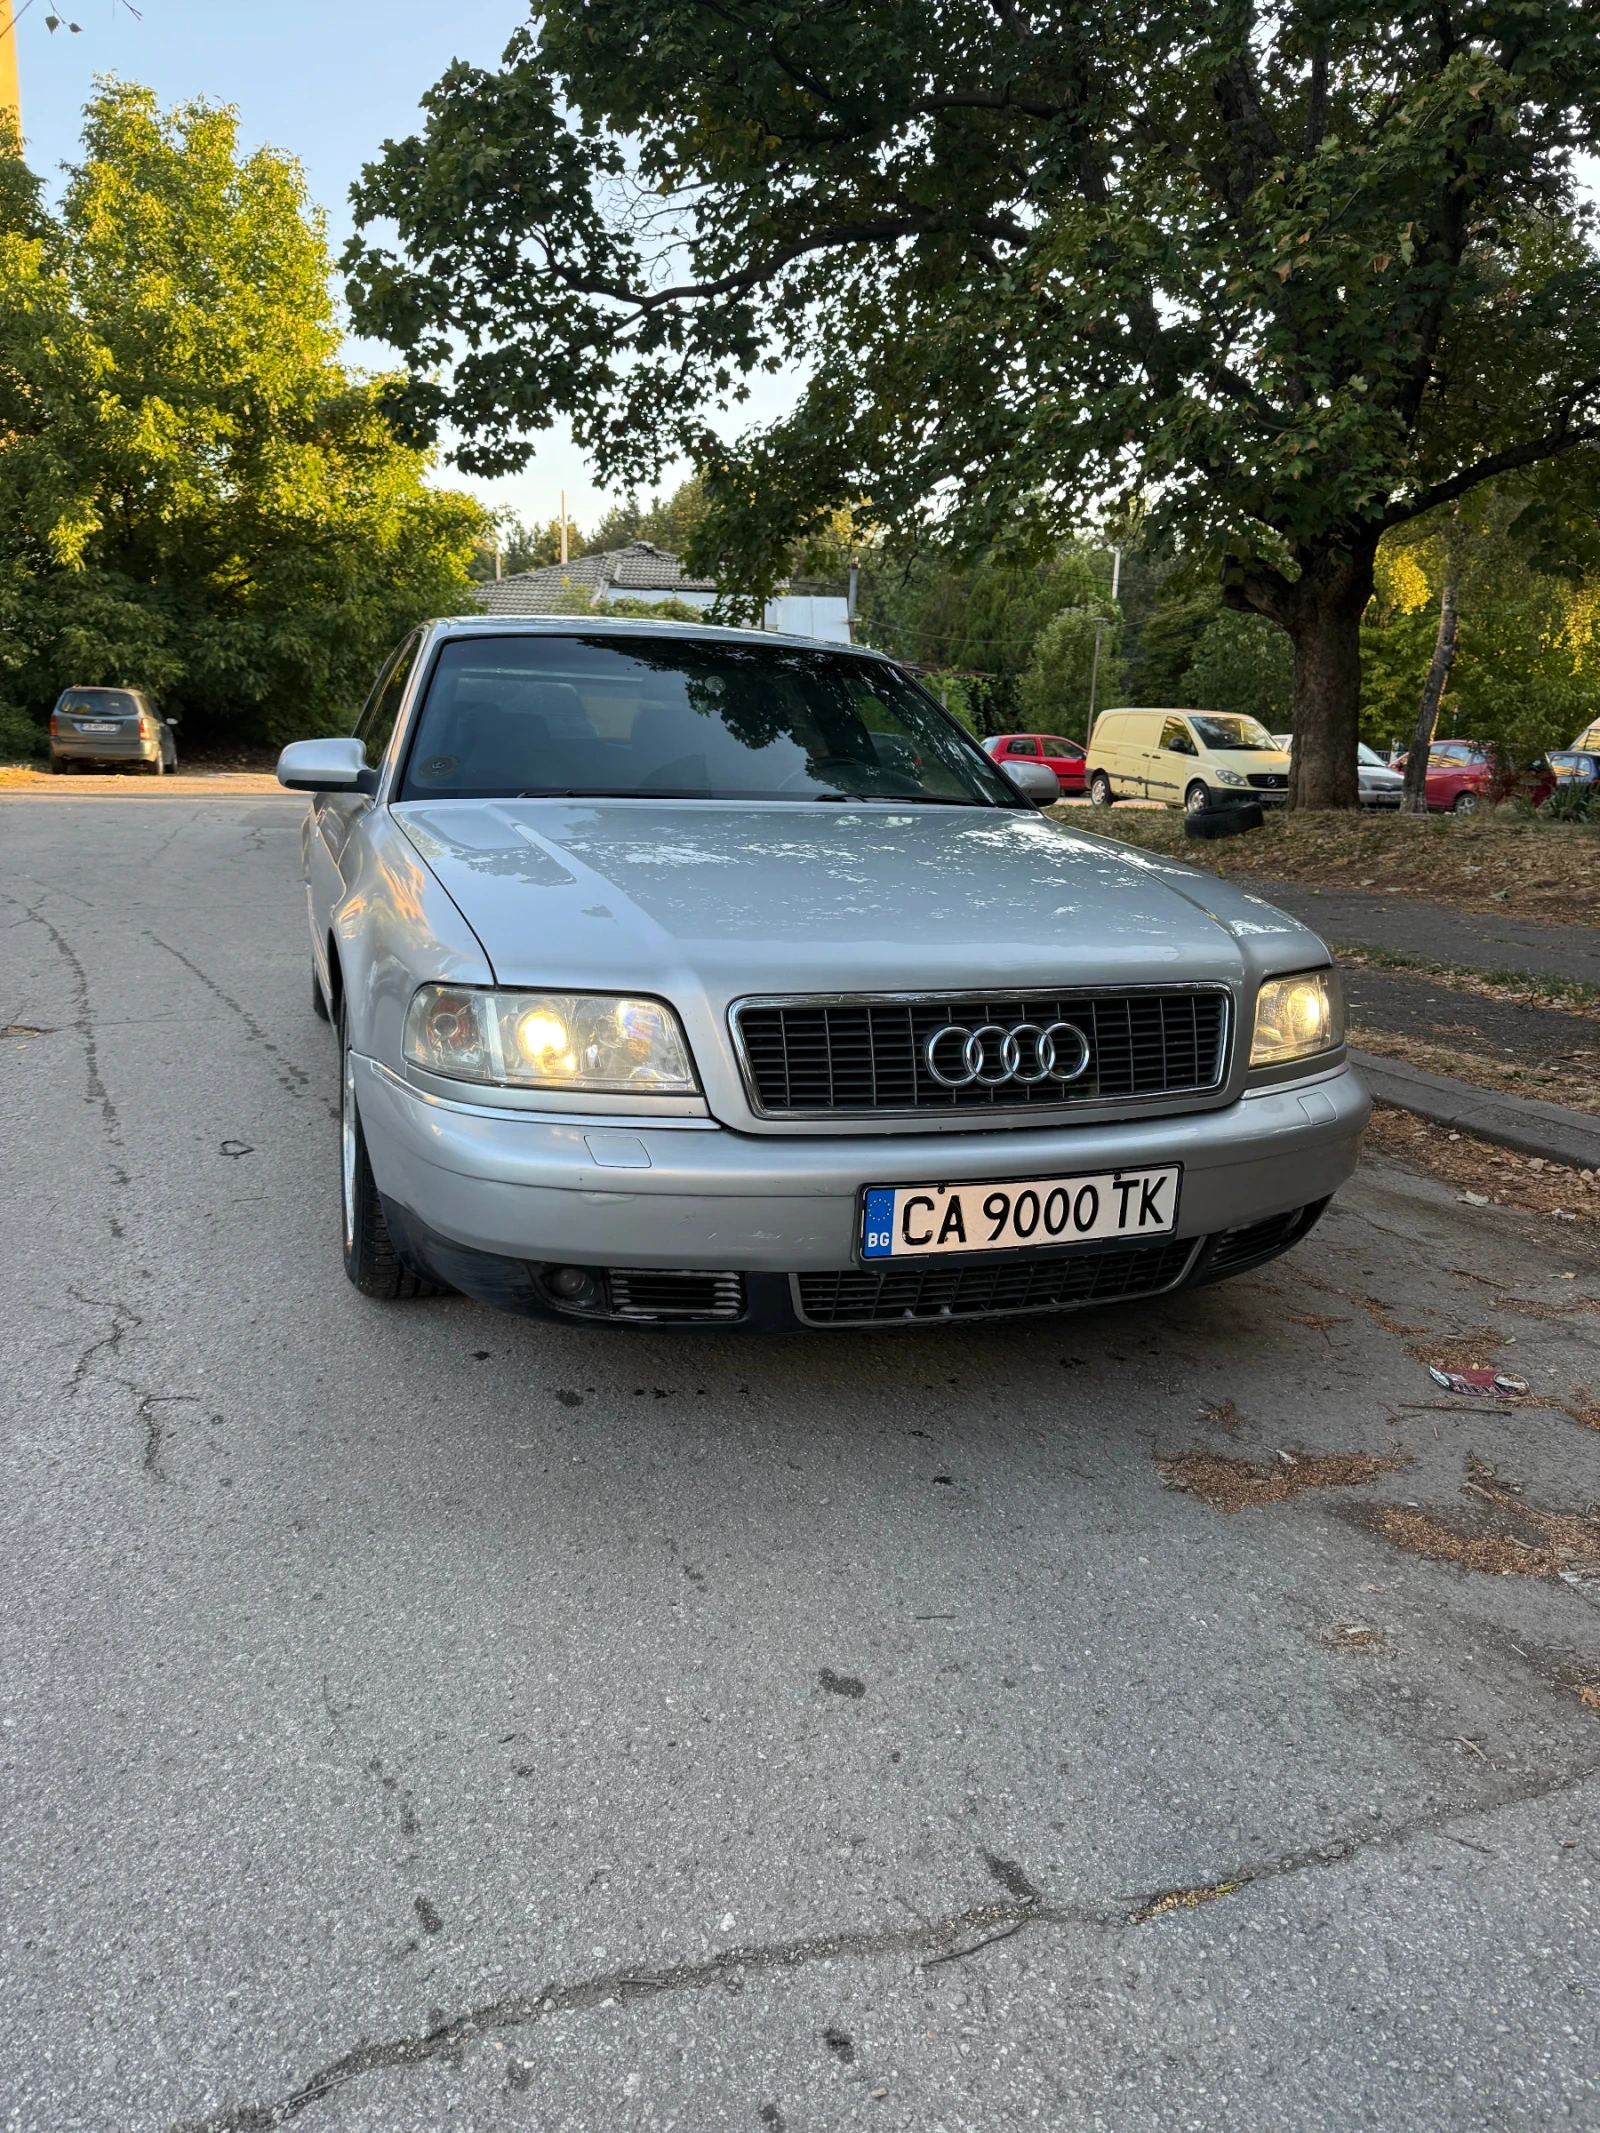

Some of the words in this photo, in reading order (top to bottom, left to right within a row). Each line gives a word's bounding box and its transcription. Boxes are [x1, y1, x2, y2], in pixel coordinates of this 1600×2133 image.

[902, 1195, 966, 1245] CA
[983, 1184, 1099, 1241] 9000
[1112, 1176, 1168, 1228] TK
[867, 1231, 890, 1248] BG
